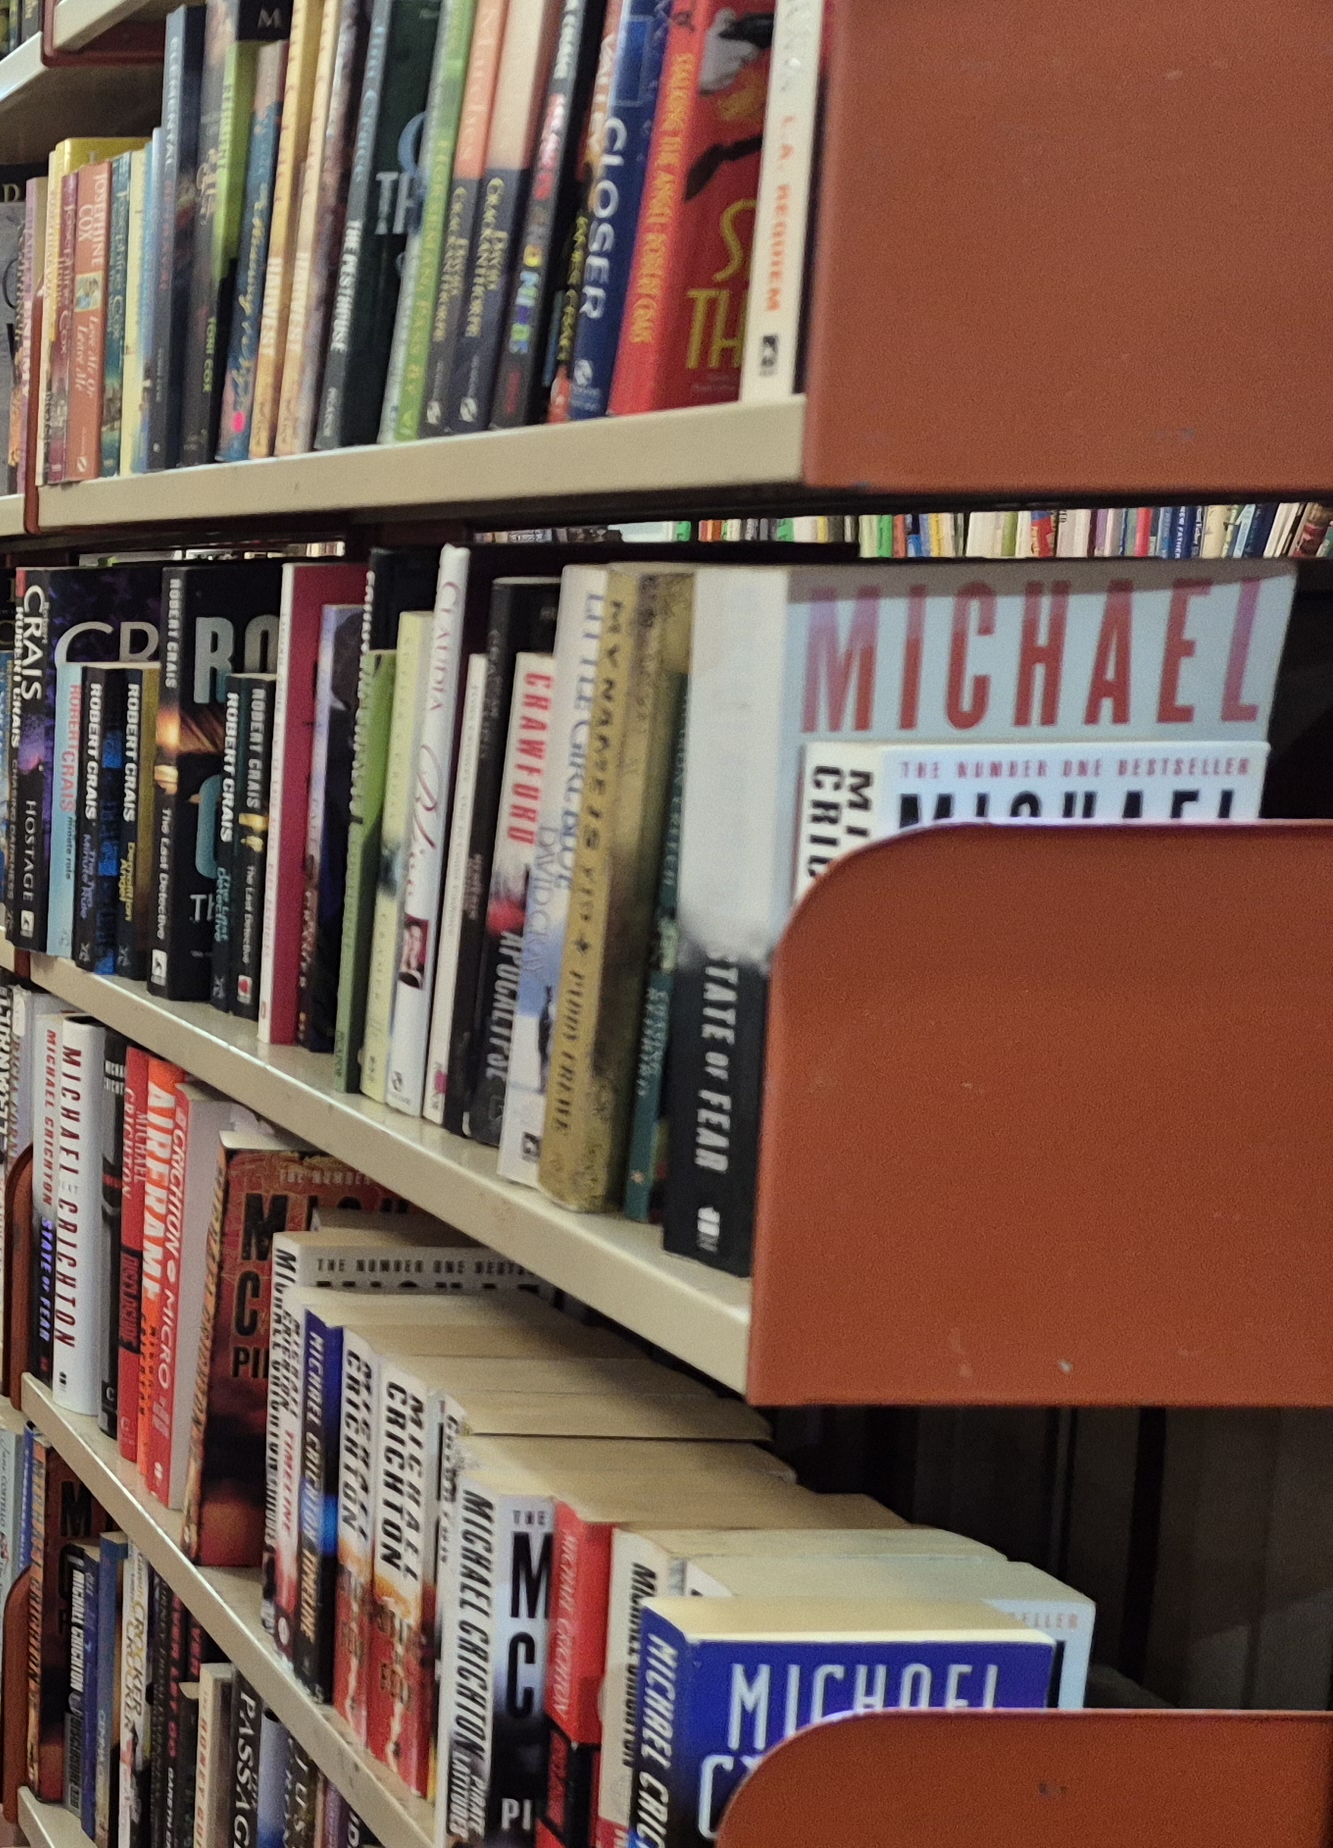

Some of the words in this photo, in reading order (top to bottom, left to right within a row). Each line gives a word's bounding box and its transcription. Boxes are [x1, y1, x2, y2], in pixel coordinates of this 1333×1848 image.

[663, 53, 695, 131] STALKING
[655, 136, 682, 166] THE
[78, 203, 93, 243] COX
[90, 173, 107, 267] JOSEPHINE
[342, 220, 363, 250] THE
[579, 117, 627, 319] CLOSER
[647, 172, 674, 225] ANGEL
[638, 232, 667, 294] ROBERT
[765, 184, 791, 313] REQUIEM
[260, 256, 283, 357] HARVEST
[331, 254, 360, 354] PESTHOUSE
[630, 298, 657, 343] CRAIS
[202, 358, 213, 393] COX
[20, 584, 46, 700] CRAIS
[168, 578, 181, 639] ROBERT
[164, 642, 179, 688] CRAIS
[800, 576, 1265, 733] MICHAEL
[66, 684, 81, 750] ROBERT
[86, 683, 102, 761] ROBERT
[125, 683, 140, 758] ROBERT
[222, 692, 239, 773] ROBERT
[247, 688, 265, 751] ROBERT
[60, 750, 77, 812] CRAIS
[84, 765, 100, 821] CRAIS
[122, 762, 139, 823] CRAIS
[245, 758, 262, 809] CRAIS
[506, 671, 555, 845] CRAWFORD
[900, 759, 940, 779] THE
[957, 758, 1048, 778] NUMBER
[1063, 757, 1103, 777] ONE
[1118, 756, 1250, 777] BESTSELLER
[160, 807, 173, 834] The
[220, 777, 236, 843] CRAIS
[585, 805, 605, 850] IS
[21, 800, 37, 902] HOSTAGE
[159, 837, 171, 869] Last
[156, 873, 170, 940] Detective
[486, 932, 528, 1082] APOCALYPSE
[43, 1028, 57, 1109] MICHAEL
[703, 1050, 730, 1081] OF
[59, 1046, 82, 1175] MICHAEL
[694, 1087, 732, 1173] FEAR
[41, 1116, 55, 1206] CRICHTON
[143, 1081, 176, 1300] AIRFRAME
[165, 1128, 186, 1253] CRICHTON
[39, 1217, 54, 1269] STATE
[41, 1275, 50, 1290] OF
[55, 1196, 78, 1348] CRICHTON
[317, 1257, 346, 1273] THE
[355, 1257, 425, 1274] NUMBER
[433, 1257, 466, 1274] ONE
[38, 1295, 52, 1342] FEAR
[157, 1288, 175, 1389] MICRO
[307, 1331, 325, 1425] MICHAEL
[341, 1350, 362, 1531] CRICHTON
[380, 1380, 410, 1571] CRICHTON
[303, 1432, 323, 1546] CRICHTON
[402, 1393, 424, 1583] MICHAEL
[513, 1509, 547, 1526] THE
[459, 1489, 495, 1622] MICHAEL
[557, 1528, 578, 1611] MICHAEL
[69, 1569, 84, 1623] MICHAEL
[300, 1548, 318, 1643] TIMELINE
[69, 1625, 84, 1692] CRICHTON
[132, 1599, 147, 1717] CROCKER
[452, 1622, 490, 1760] CRICHTON
[553, 1617, 575, 1721] CRICHTON
[641, 1632, 677, 1769] MICHAEL
[448, 1750, 471, 1842] LATITUDES
